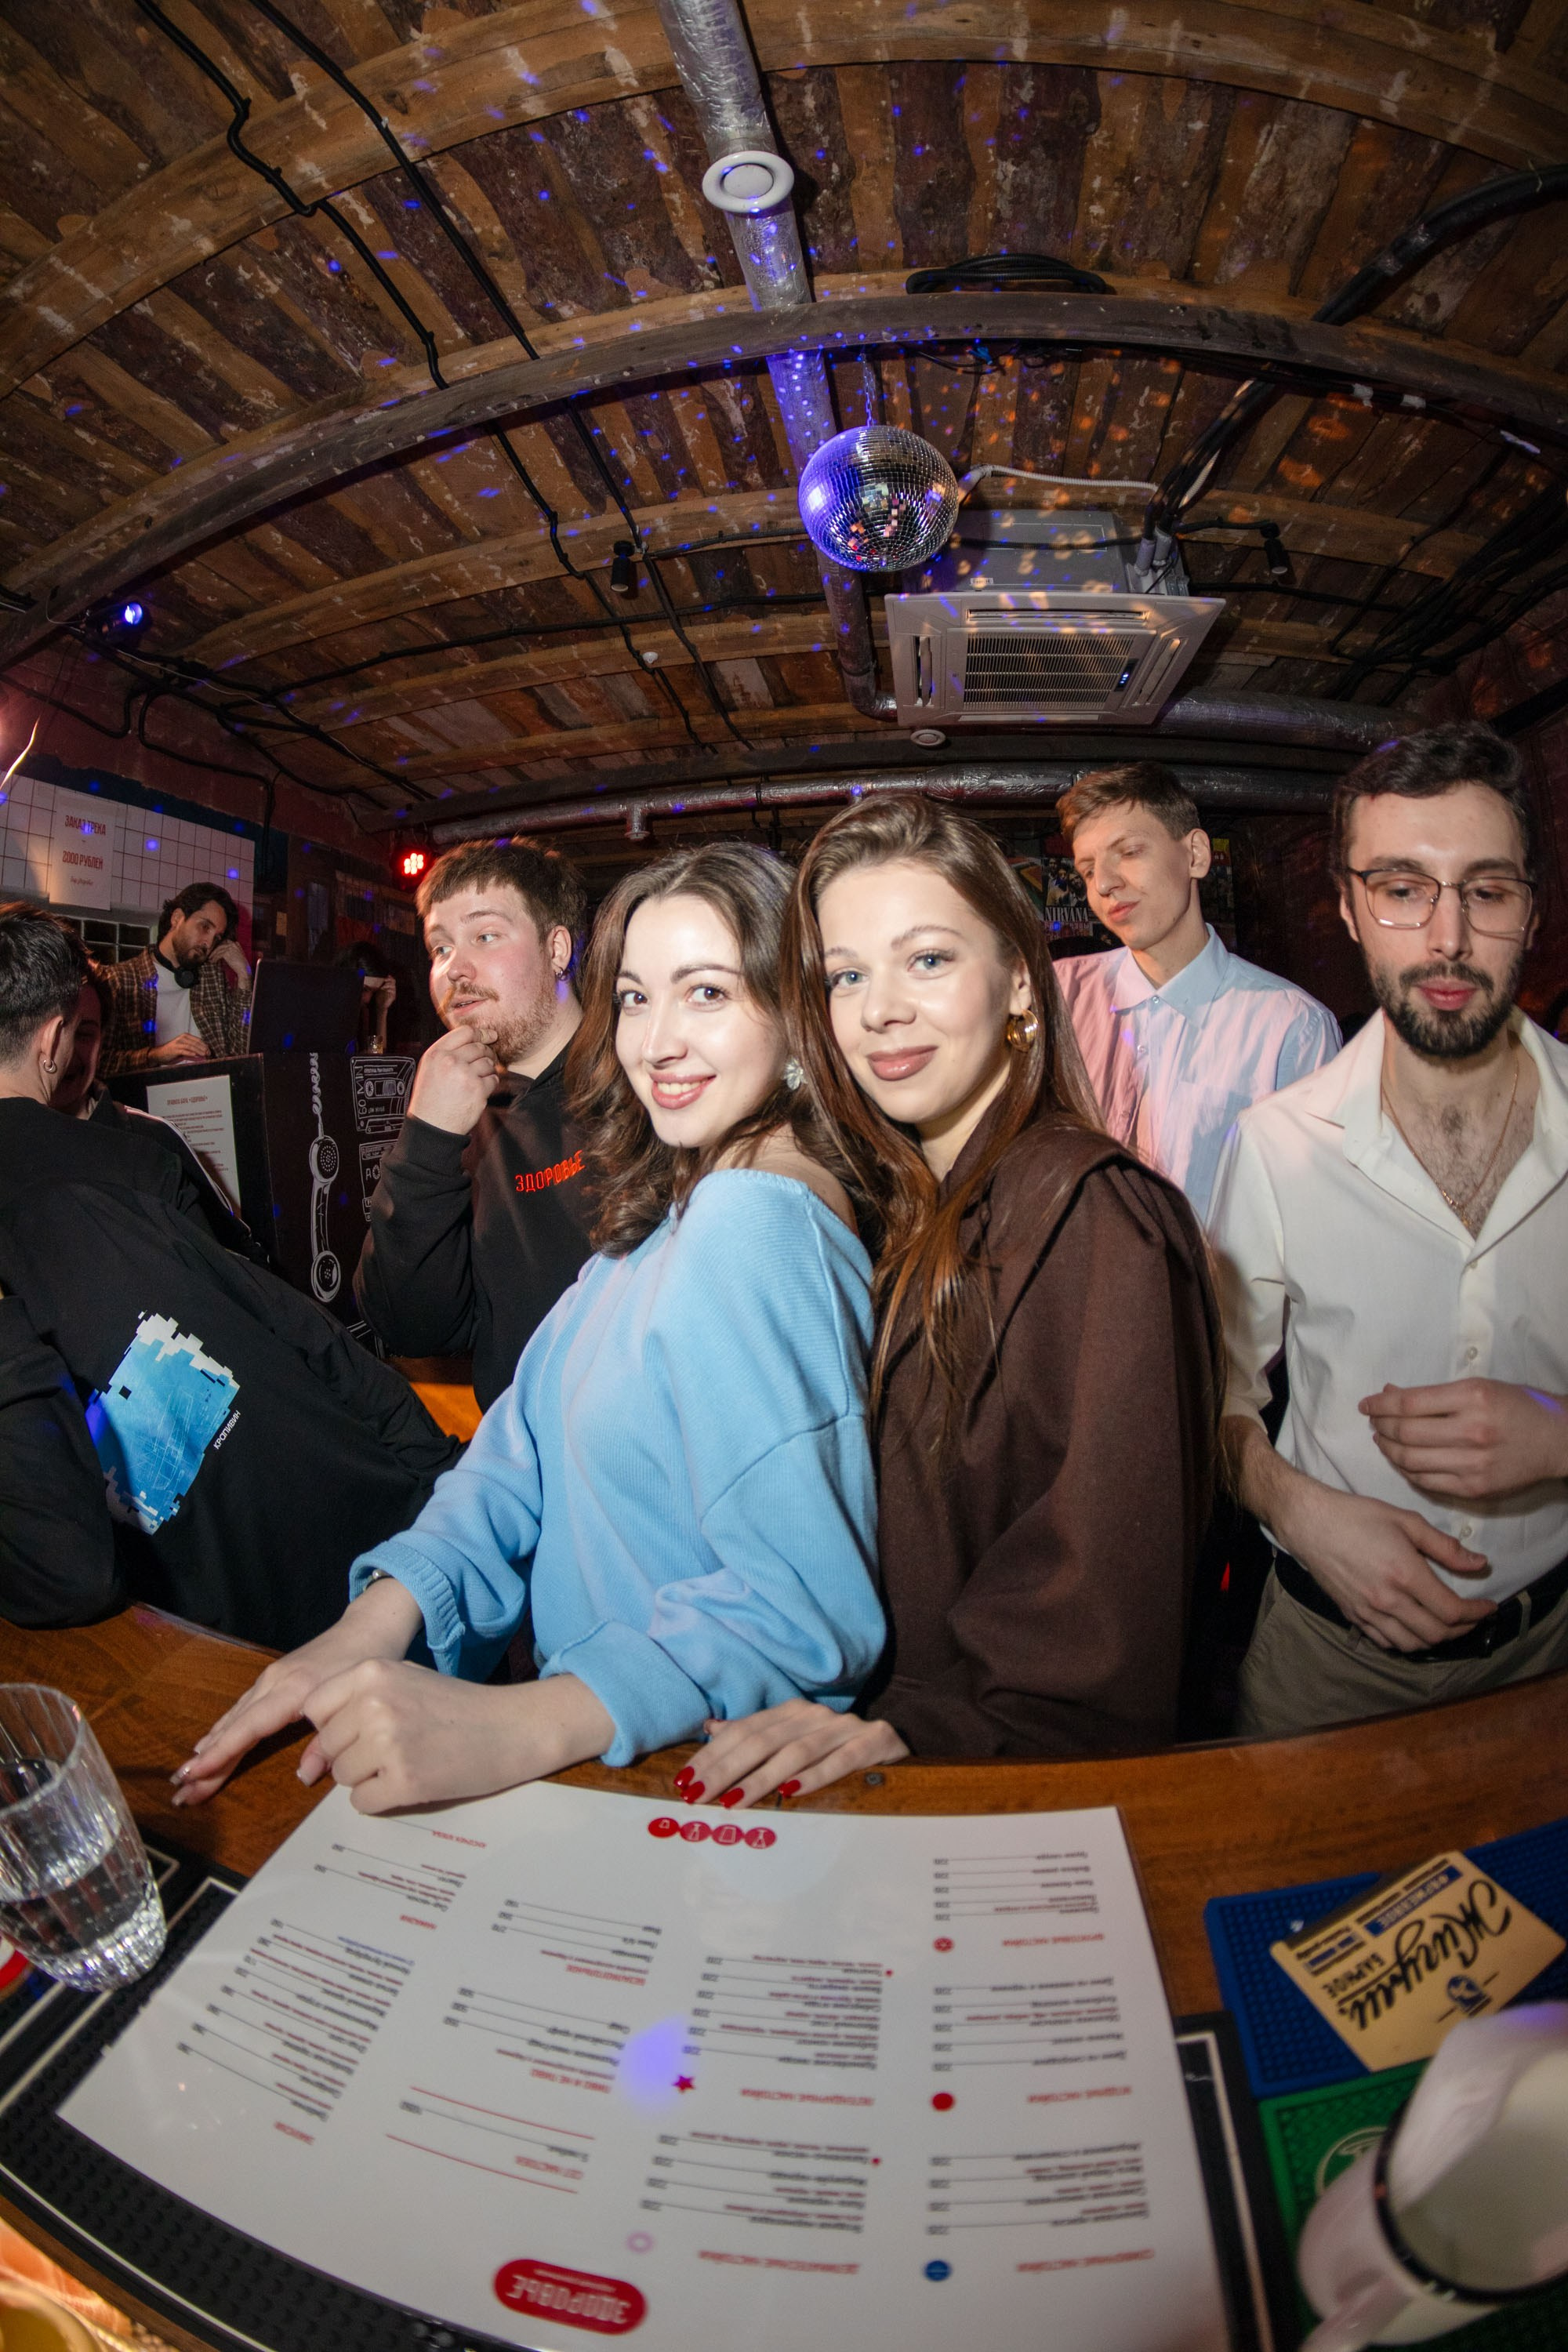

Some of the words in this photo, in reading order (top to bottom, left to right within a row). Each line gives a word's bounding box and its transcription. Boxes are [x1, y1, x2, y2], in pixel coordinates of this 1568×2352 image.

[65, 815, 85, 831] ЗАКАЗ
[86, 820, 107, 835] ТРЕКА
[63, 850, 78, 865] 2000
[79, 854, 103, 869] РУБЛЕЙ
[1045, 906, 1089, 923] NIRVANA
[354, 1066, 365, 1094] MIN
[358, 1099, 368, 1114] 60
[515, 1149, 586, 1192] ЗДОРОВЬЕ
[505, 2274, 631, 2325] ЗДОРОВЬЕ
